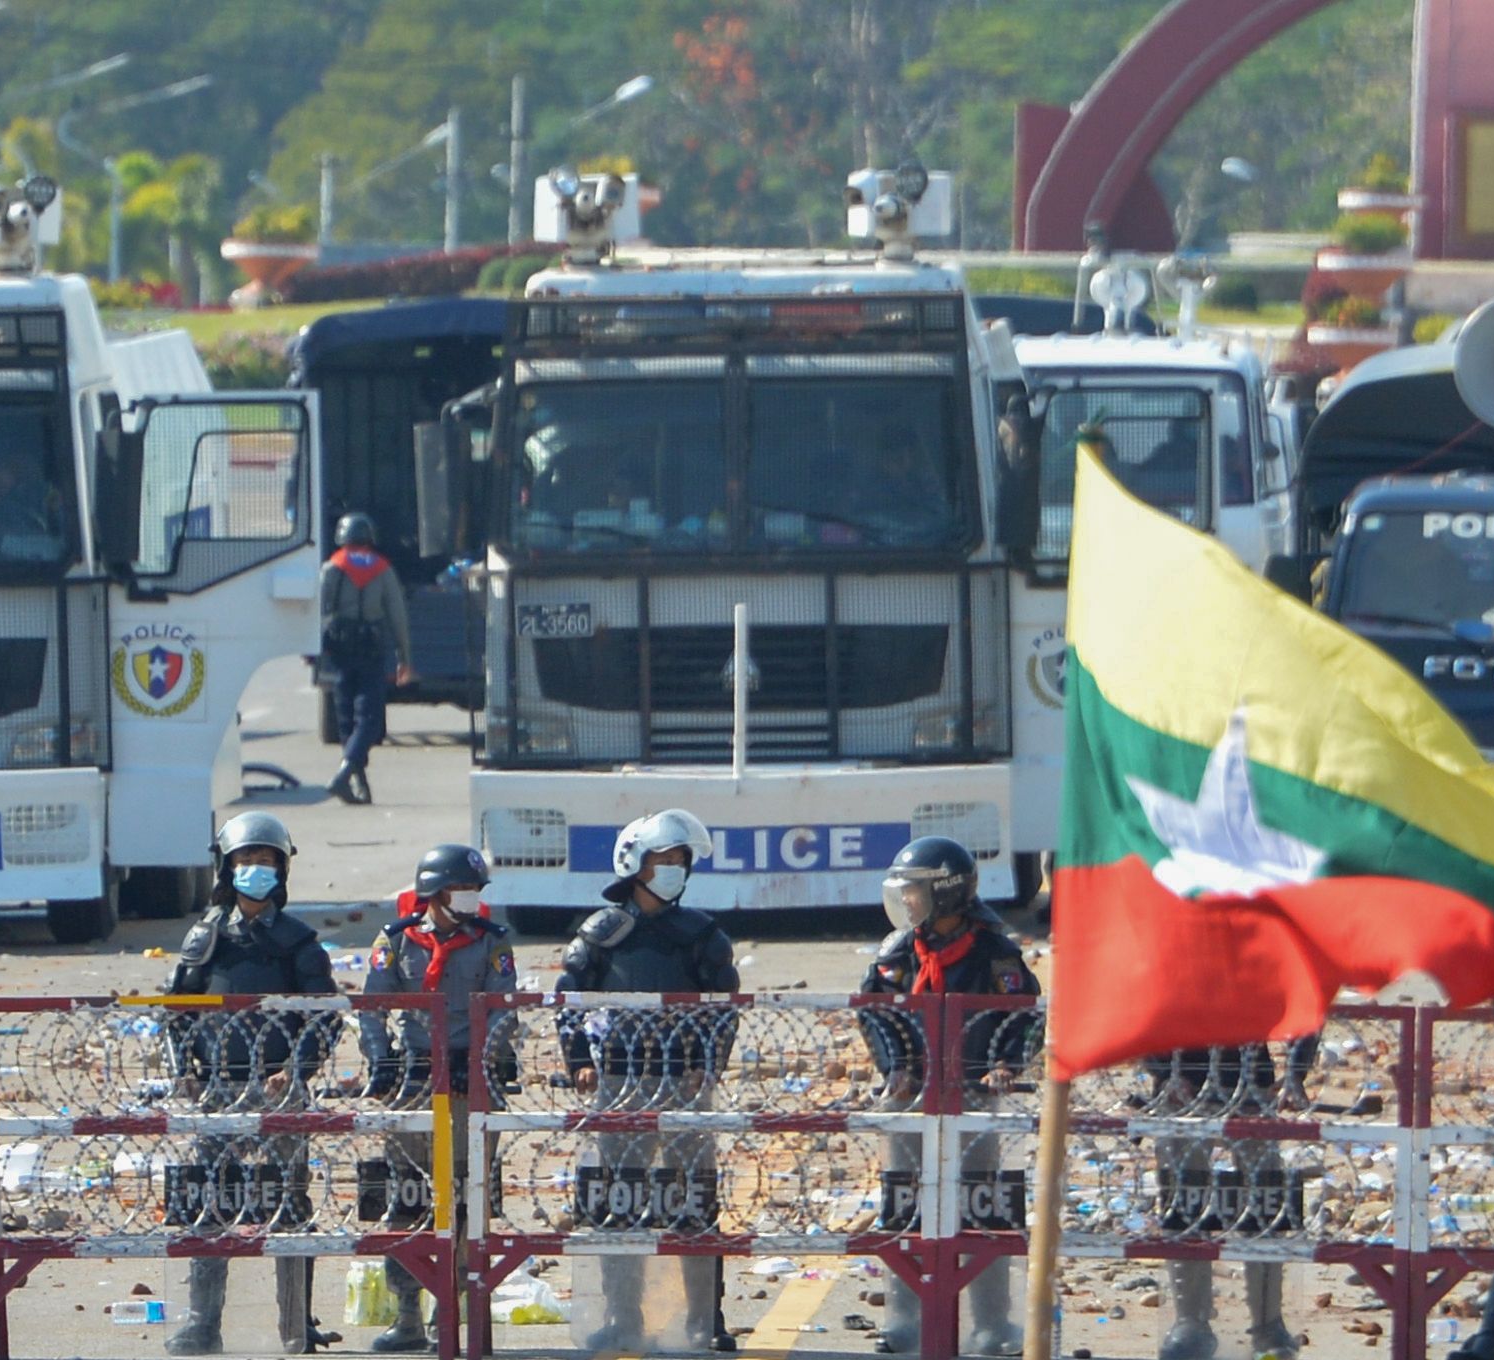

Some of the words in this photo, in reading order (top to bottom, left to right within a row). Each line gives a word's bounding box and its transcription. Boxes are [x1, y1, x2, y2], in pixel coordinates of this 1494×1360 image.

[120, 623, 197, 649] POLICE
[712, 827, 864, 870] LICE
[587, 1179, 706, 1217] POLICE
[894, 1184, 1013, 1218] PICE
